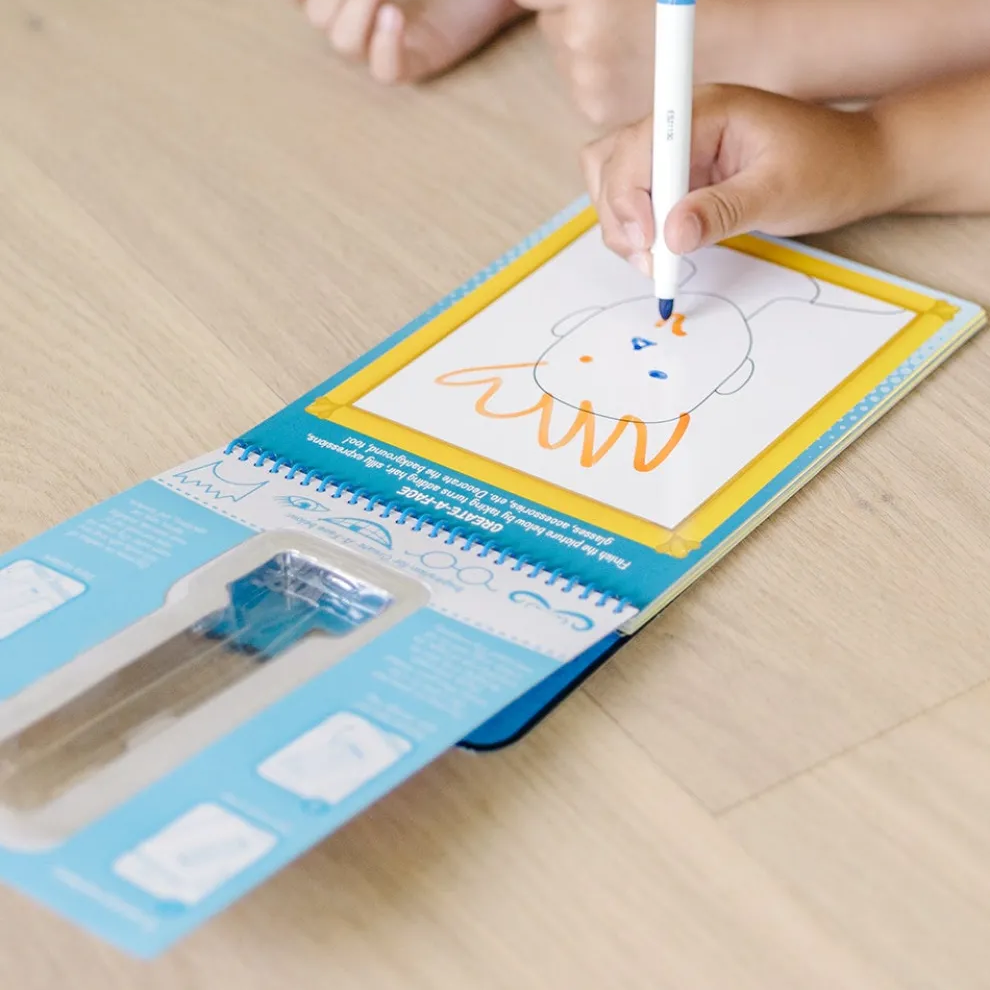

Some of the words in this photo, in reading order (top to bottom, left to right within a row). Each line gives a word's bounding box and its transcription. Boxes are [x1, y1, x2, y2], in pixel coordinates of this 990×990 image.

[307, 433, 364, 460] expressions,
[341, 436, 365, 448] too!
[363, 455, 384, 468] silly
[366, 443, 426, 472] background,
[385, 464, 407, 479] hair,
[424, 468, 441, 478] the
[406, 472, 440, 491] adding
[442, 475, 488, 499] Decorate
[440, 487, 468, 503] turns
[490, 493, 507, 504] etc.
[396, 485, 503, 532] CREATE-A-FACE
[468, 496, 500, 516] taking
[509, 499, 570, 528] accessories,
[500, 510, 516, 523] by
[514, 518, 546, 535] below
[572, 524, 613, 545] glasses,
[545, 530, 584, 548] picture
[580, 544, 598, 555] the
[598, 550, 631, 569] Finish
